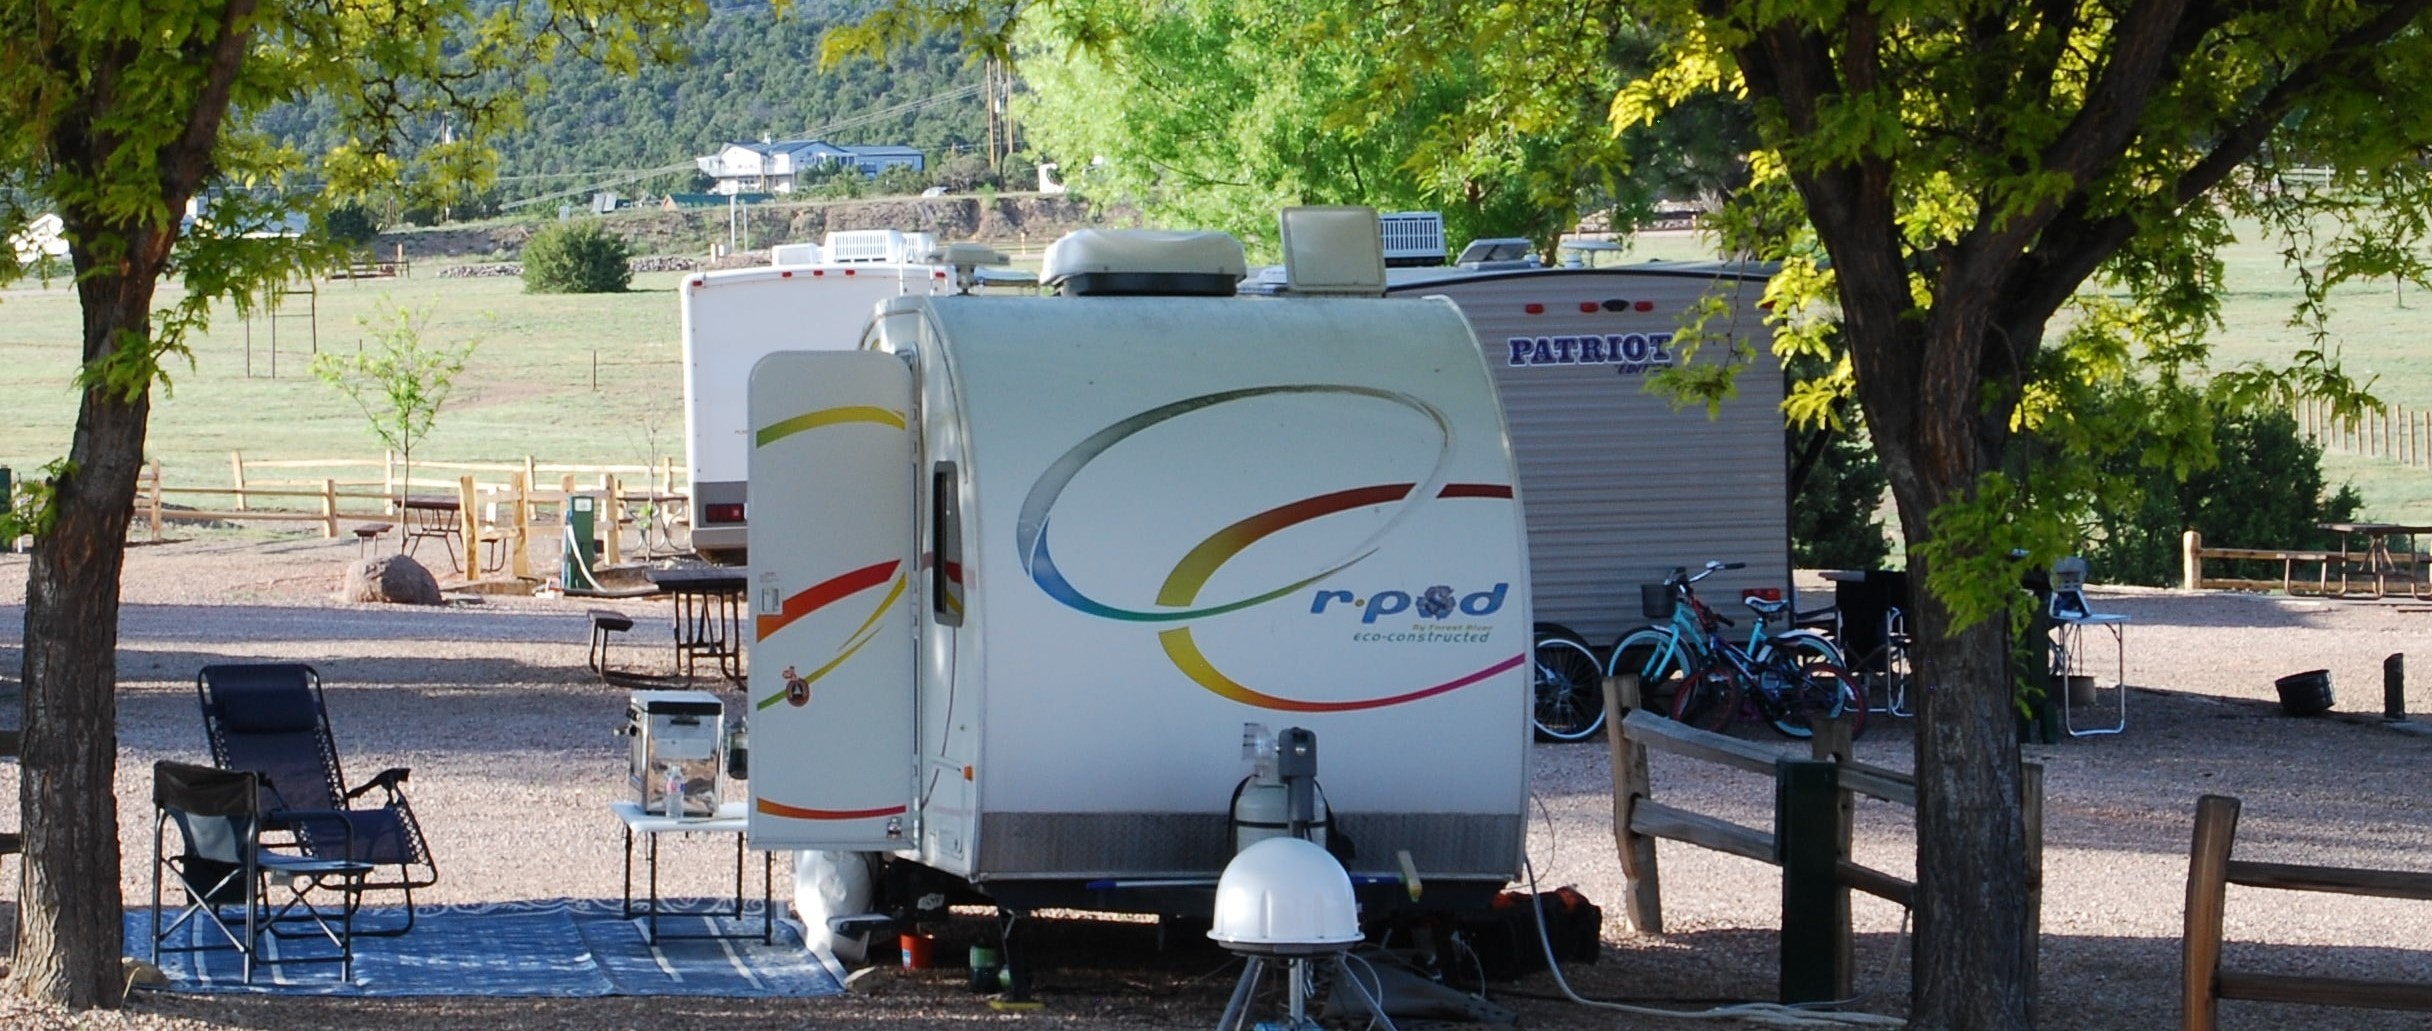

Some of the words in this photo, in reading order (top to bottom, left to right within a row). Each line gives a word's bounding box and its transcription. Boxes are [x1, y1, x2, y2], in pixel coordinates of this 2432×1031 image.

[1509, 333, 1673, 366] PATRIOT
[1616, 362, 1673, 375] EDIT
[1353, 631, 1490, 643] eco-constructed
